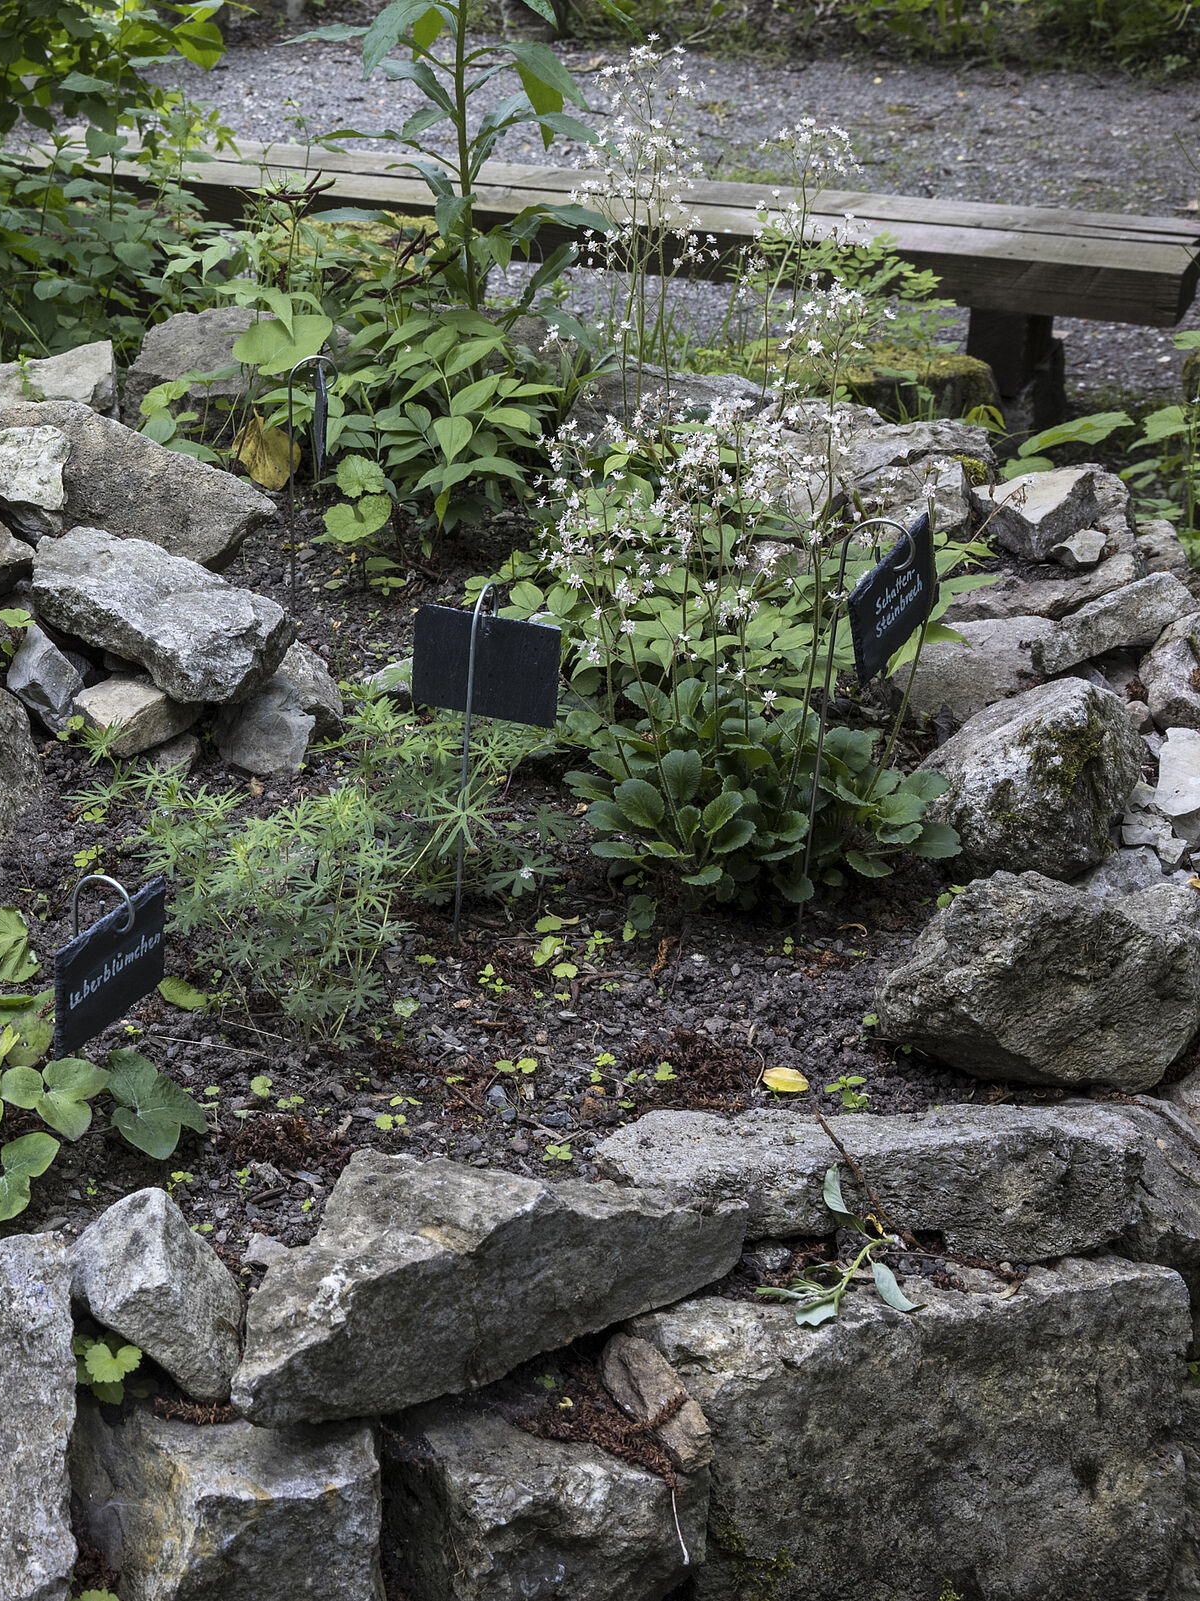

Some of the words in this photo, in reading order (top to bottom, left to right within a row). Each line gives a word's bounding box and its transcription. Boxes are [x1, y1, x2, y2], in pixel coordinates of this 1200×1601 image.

[875, 568, 916, 615] Schatten-
[875, 573, 923, 638] Steinbrech
[69, 931, 161, 1010] Leberblümchen
